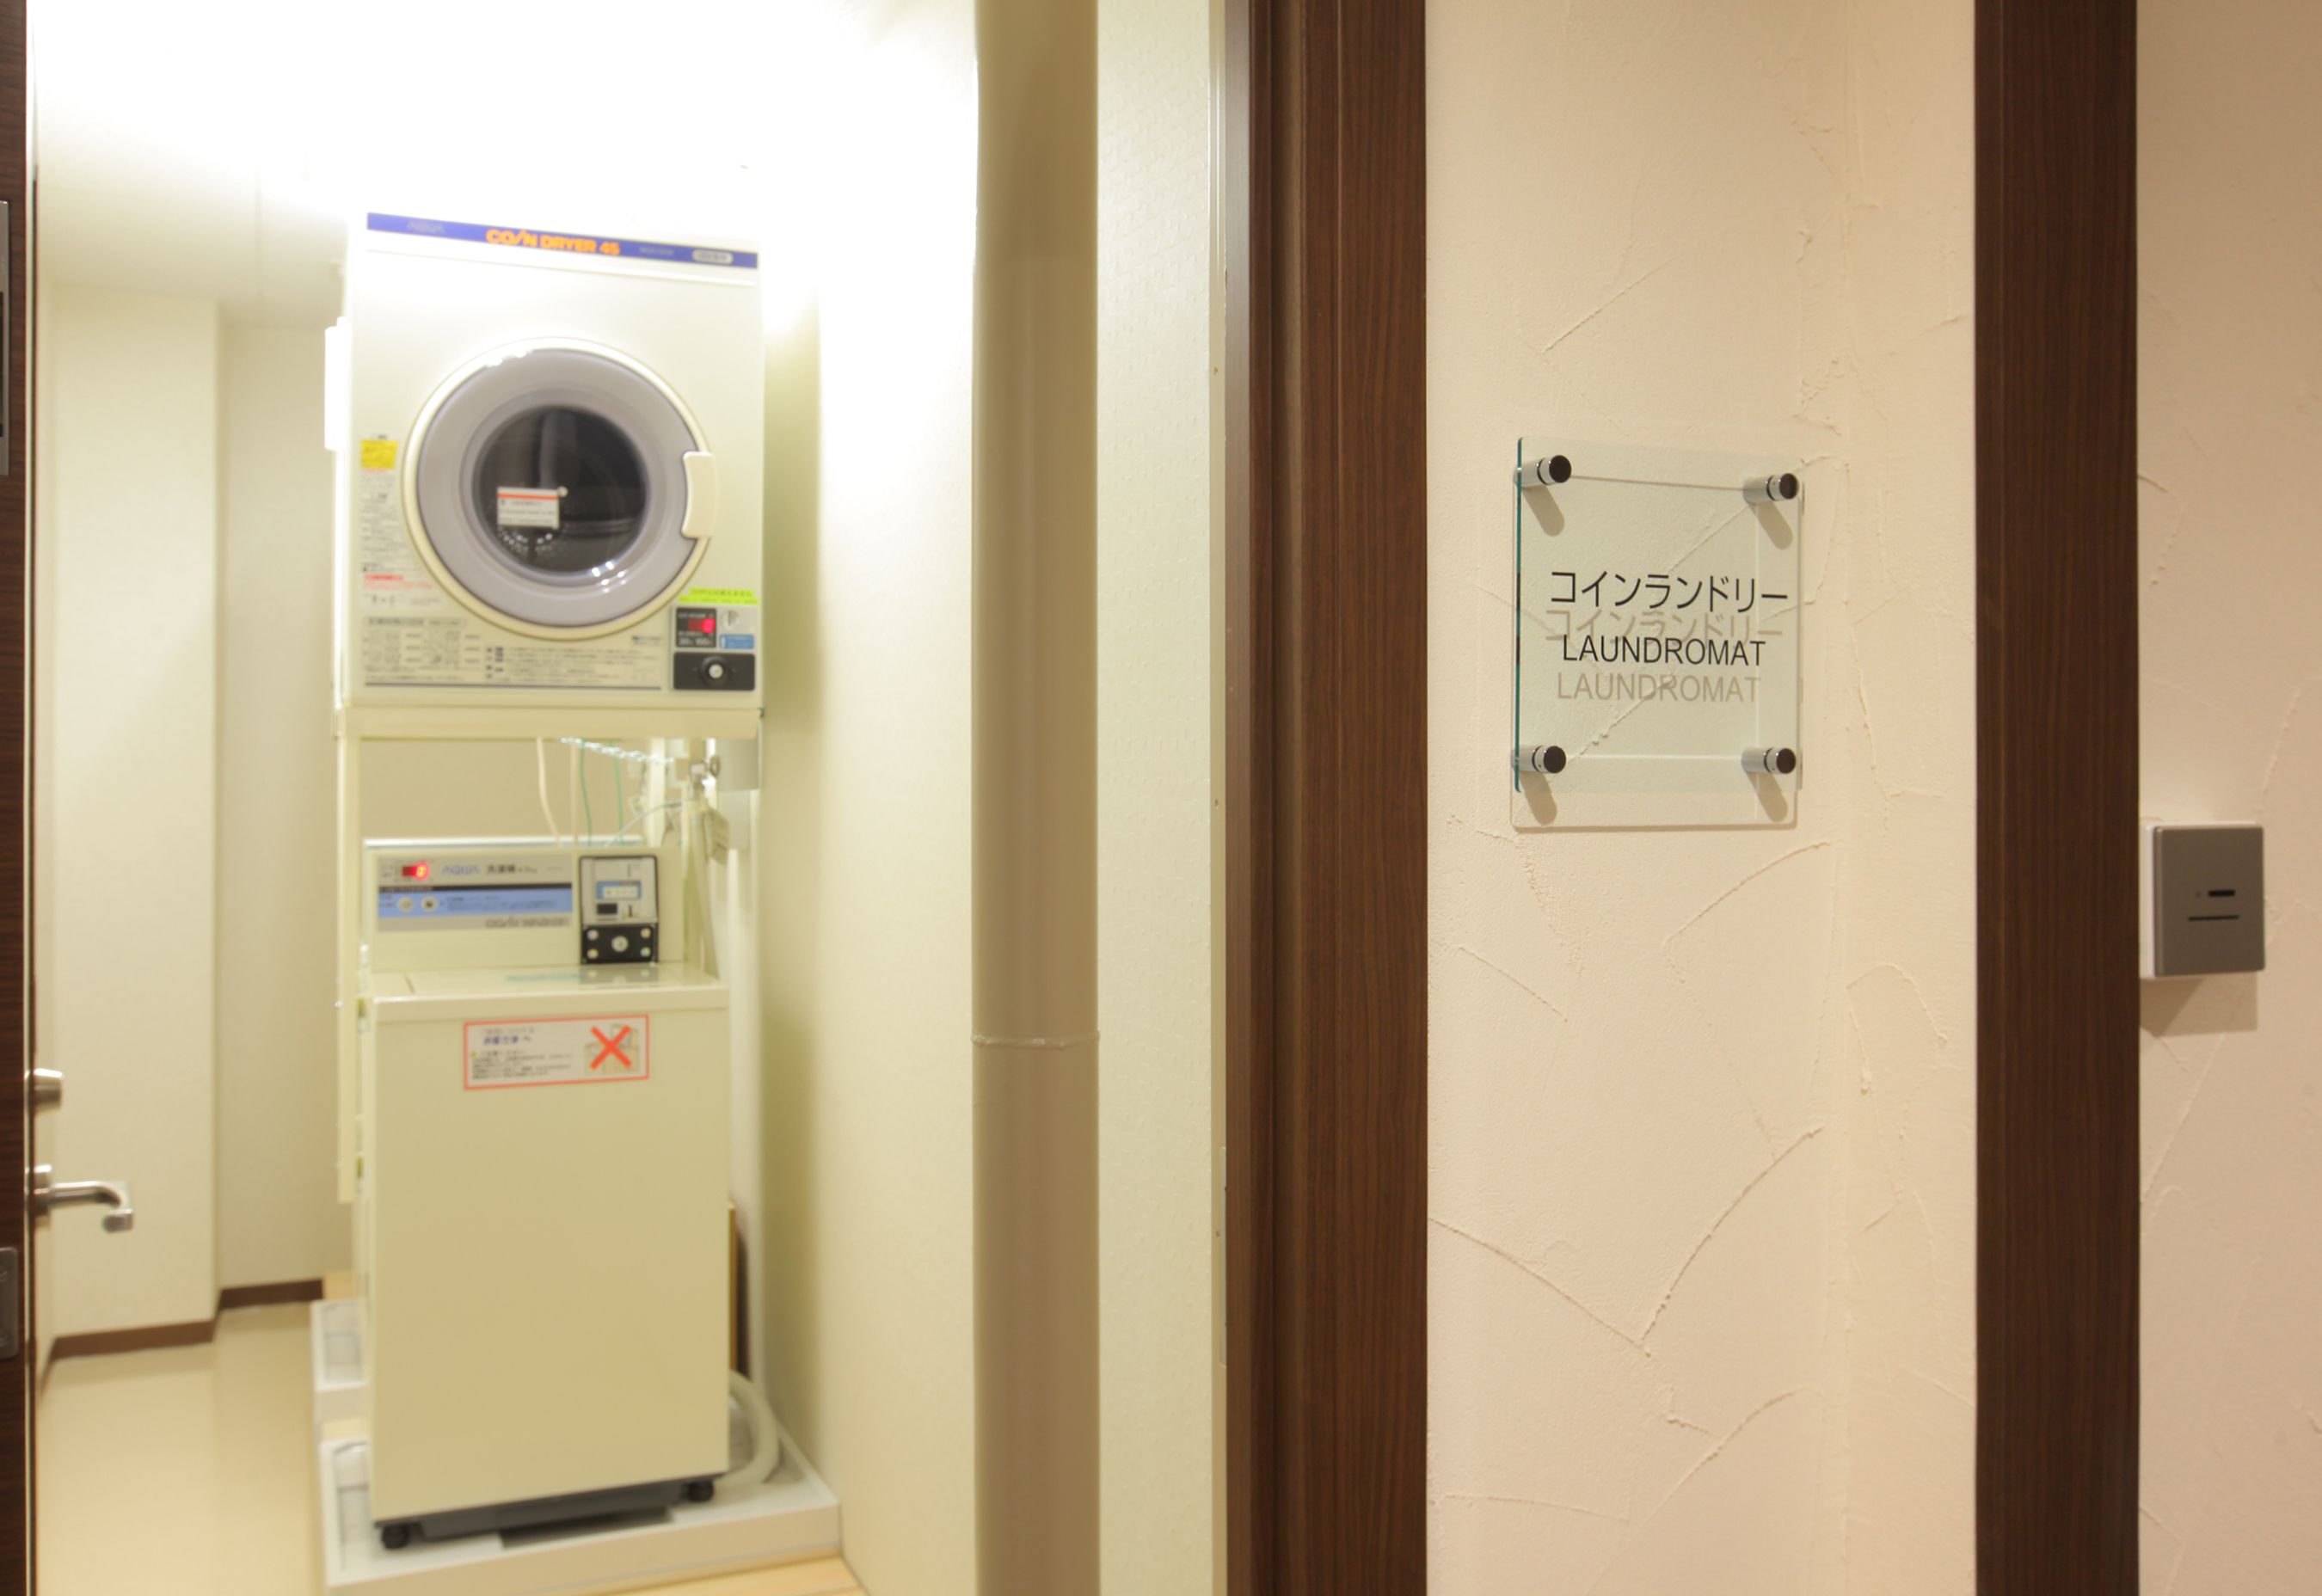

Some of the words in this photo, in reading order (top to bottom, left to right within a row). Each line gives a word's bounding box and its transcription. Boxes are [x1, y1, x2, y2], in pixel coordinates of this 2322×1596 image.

[540, 235, 597, 254] DRYER
[599, 241, 620, 255] 45
[1551, 570, 1788, 613] コインランドリー
[1563, 635, 1766, 666] LAUNDROMAT
